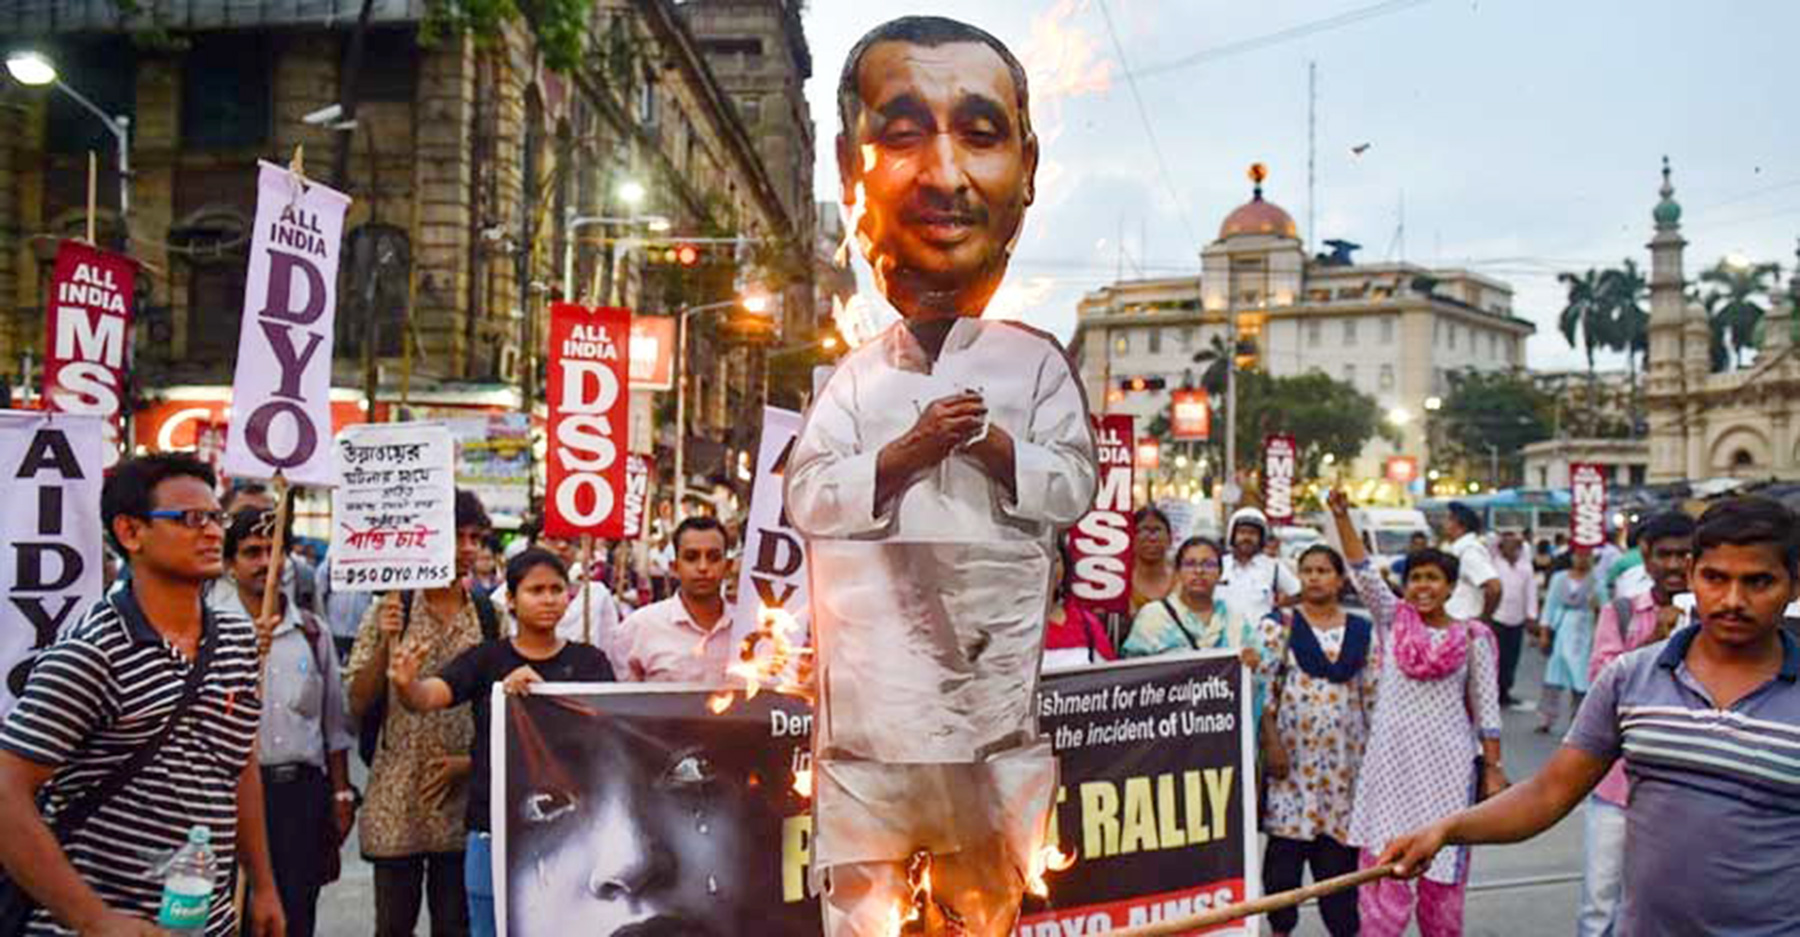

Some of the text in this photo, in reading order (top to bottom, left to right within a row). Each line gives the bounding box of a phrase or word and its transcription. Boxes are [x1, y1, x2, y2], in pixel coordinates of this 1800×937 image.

[280, 204, 322, 234] ALL
[270, 223, 327, 258] INDIA
[72, 263, 117, 291] ALL
[59, 282, 126, 314] INDIA
[571, 324, 612, 343] ALL
[244, 248, 328, 469] DYO
[562, 340, 618, 360] INDIA
[555, 358, 619, 527] DSO
[1096, 429, 1122, 446] LL
[346, 567, 378, 584] DSO
[417, 564, 448, 580] MSS
[1112, 685, 1138, 709] for
[1140, 682, 1165, 706] the
[1168, 675, 1234, 706] culprits,
[1055, 725, 1083, 749] the
[1086, 718, 1155, 745] incident
[1158, 718, 1178, 737] of
[1181, 710, 1235, 737] Unnao
[1080, 766, 1235, 860] RALLY
